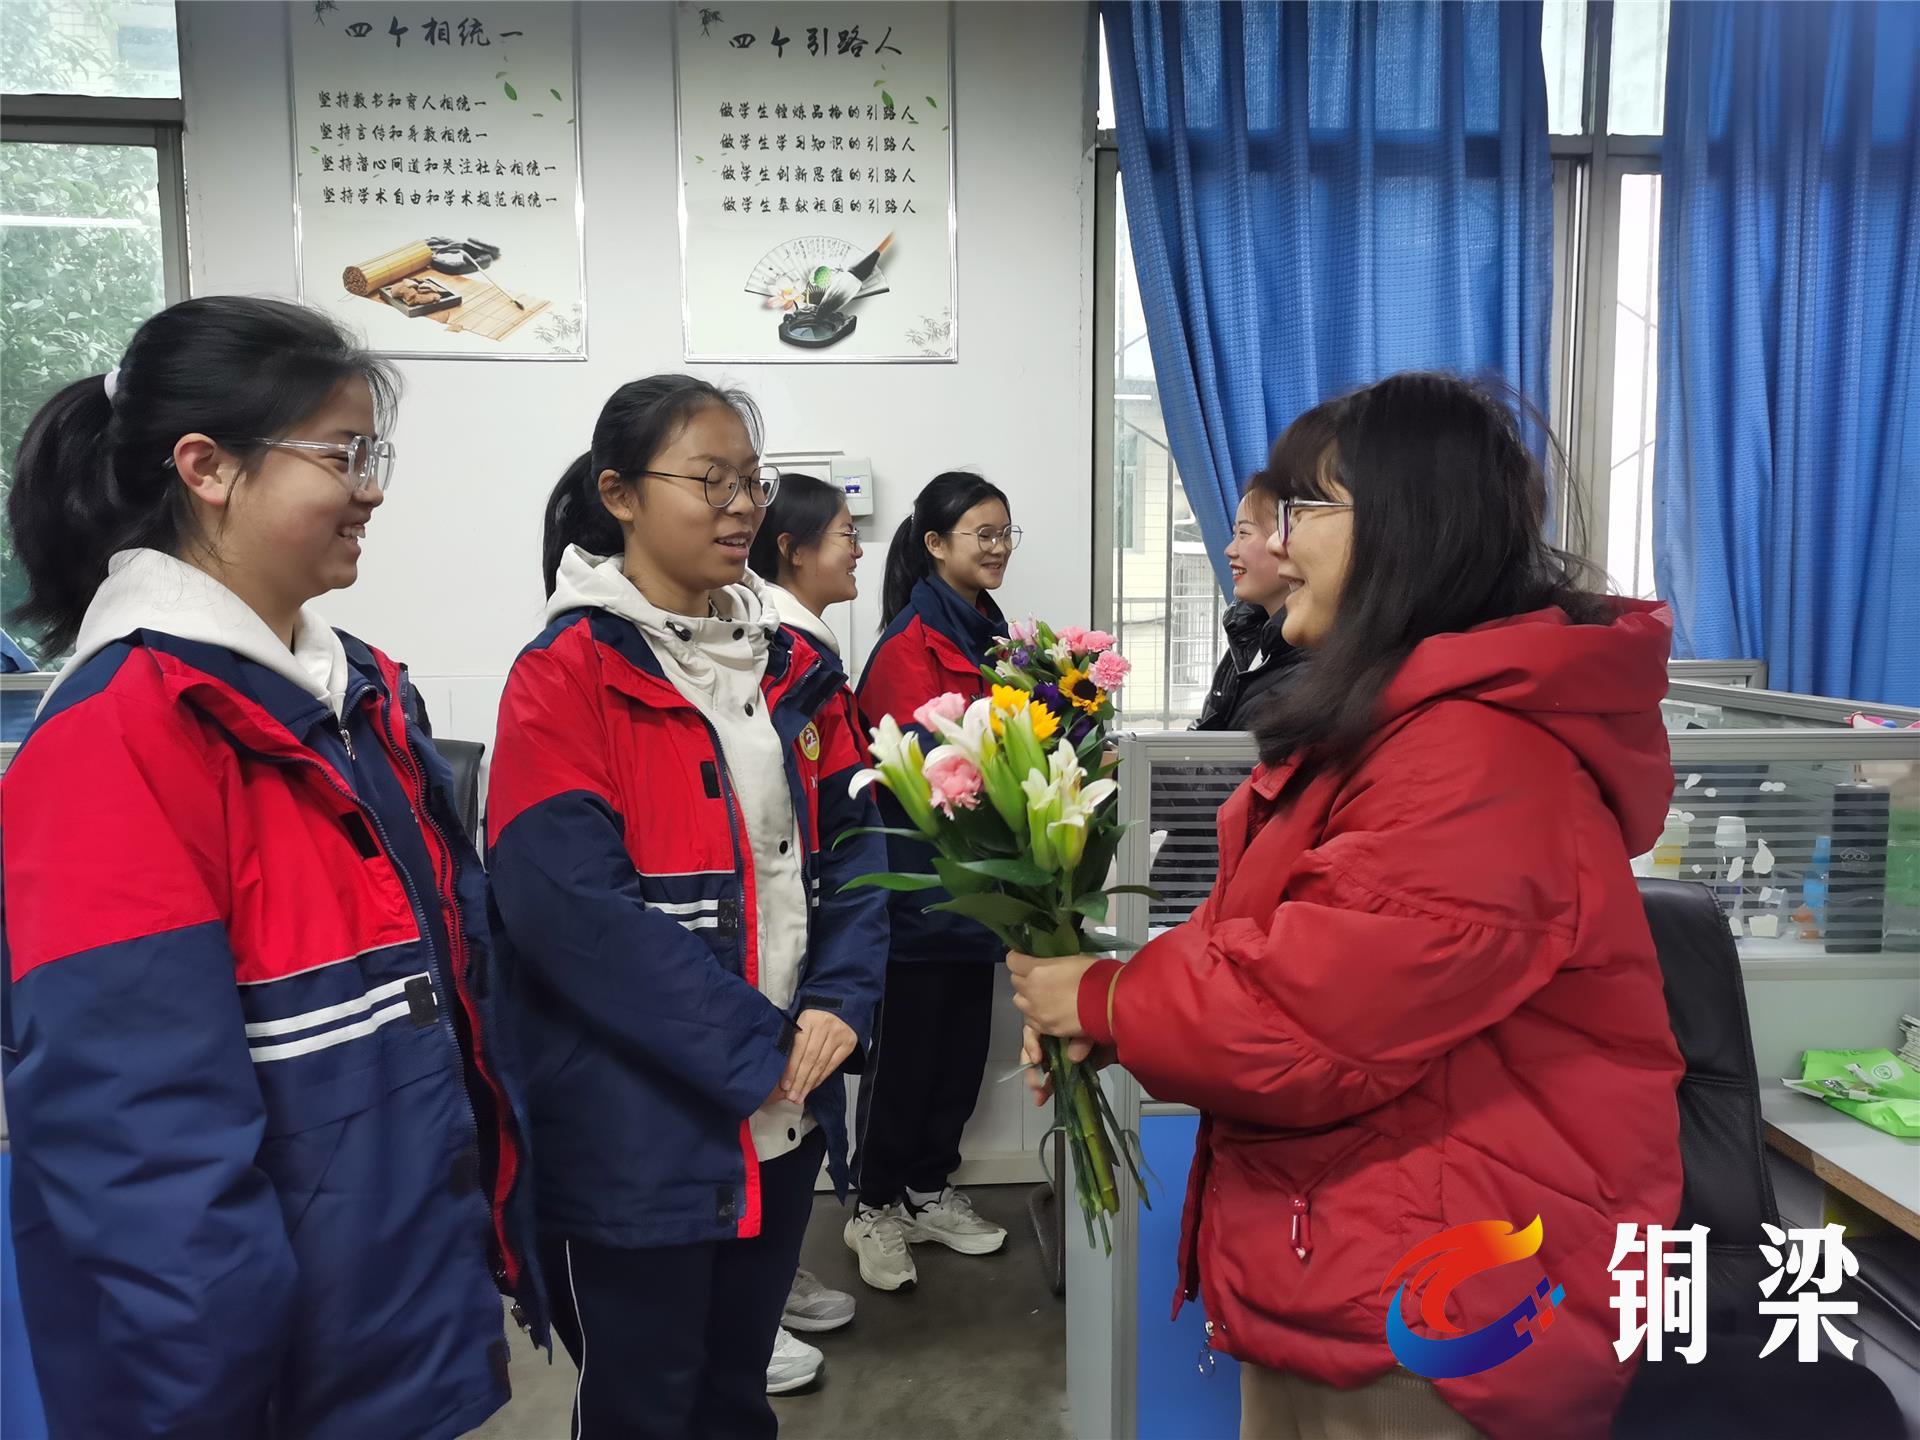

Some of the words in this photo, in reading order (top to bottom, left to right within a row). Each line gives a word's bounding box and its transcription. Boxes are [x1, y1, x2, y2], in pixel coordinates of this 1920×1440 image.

[344, 16, 524, 48] 四个相统一
[728, 25, 902, 58] 四个引路人
[318, 90, 487, 112] 坚持教书和育人相统一
[319, 122, 488, 144] 坚持言传和身教相统一
[720, 132, 916, 152] 做学生学习知识的引路人
[721, 164, 916, 183] 做学生创新思维的引路人
[323, 186, 558, 208] 坚持学术自由和学术规范相统一
[722, 195, 917, 214] 做学生奉献祖国的引路人
